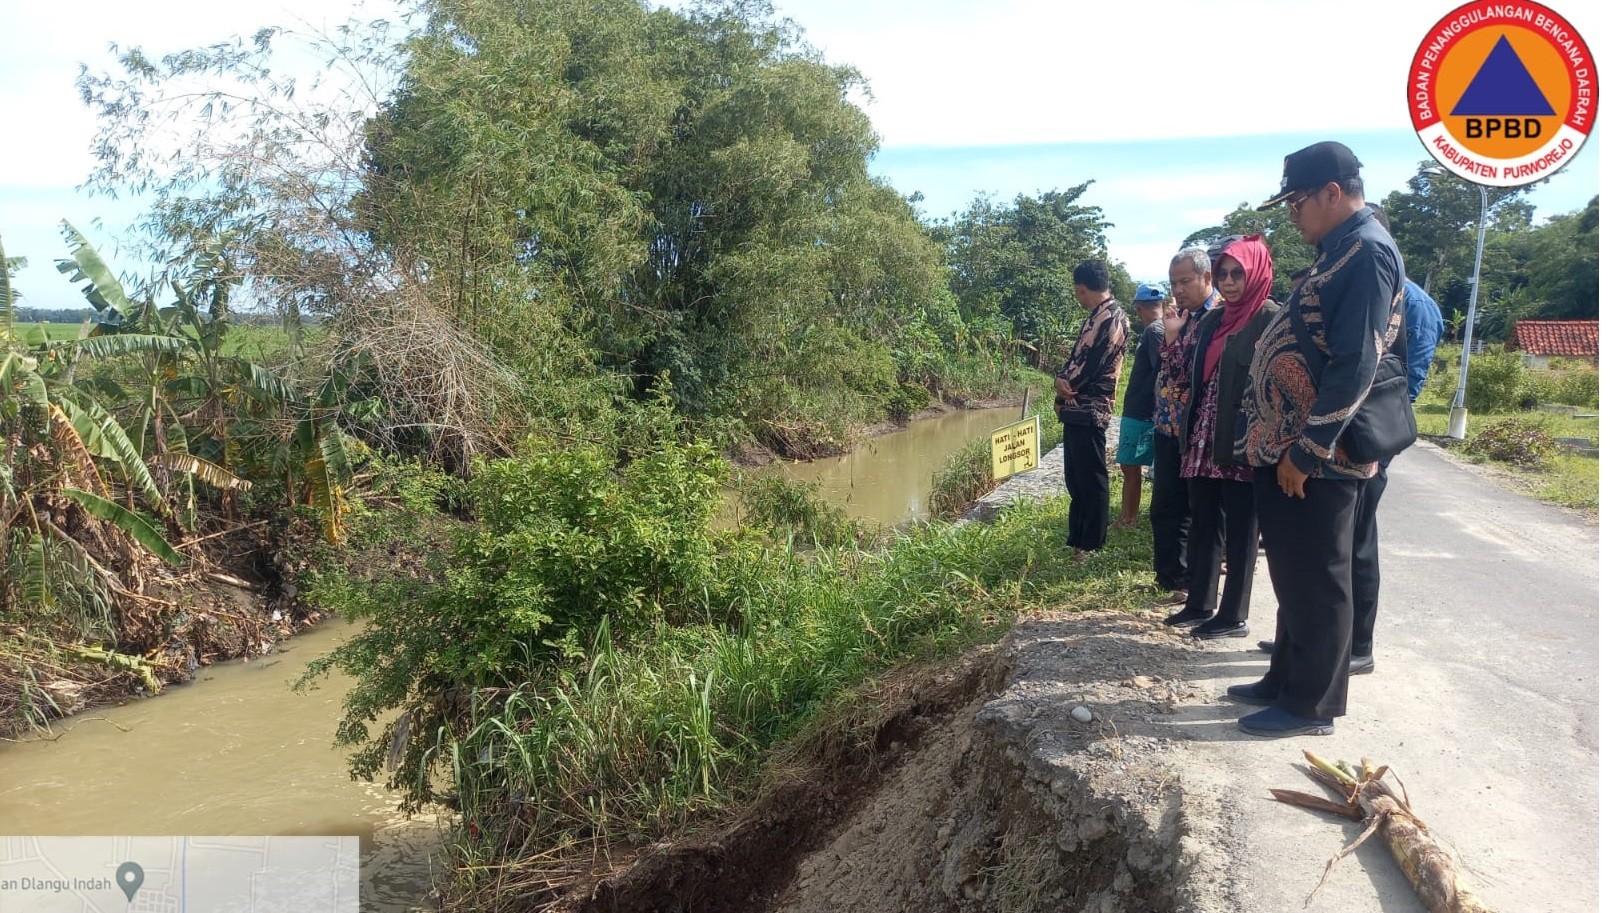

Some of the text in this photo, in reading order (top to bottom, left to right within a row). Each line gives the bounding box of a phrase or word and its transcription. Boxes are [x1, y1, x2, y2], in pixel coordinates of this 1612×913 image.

[995, 434, 1010, 444] HATI
[1018, 426, 1033, 437] HATI
[1004, 439, 1025, 451] JALAN
[999, 448, 1030, 463] LONGSOR
